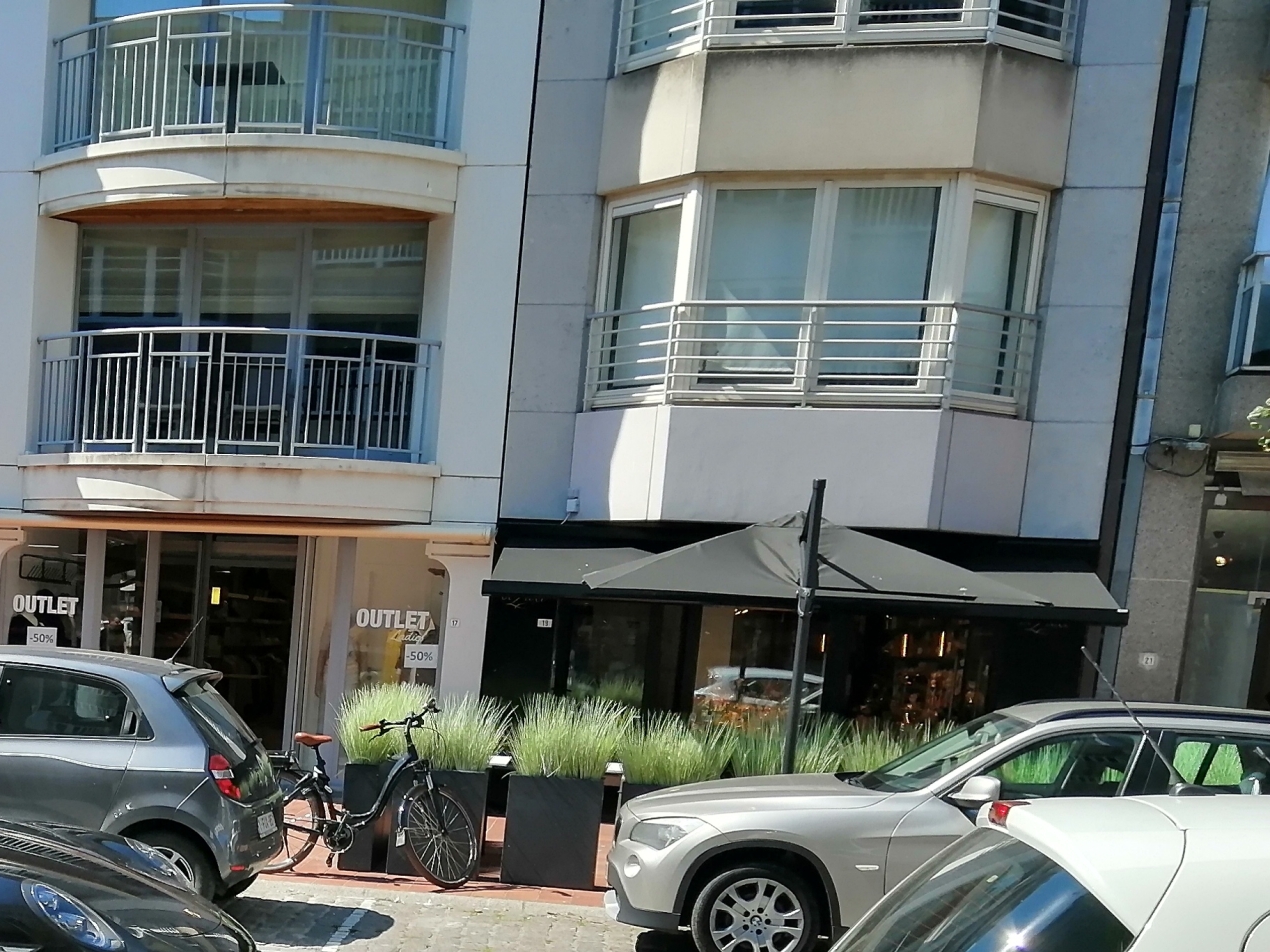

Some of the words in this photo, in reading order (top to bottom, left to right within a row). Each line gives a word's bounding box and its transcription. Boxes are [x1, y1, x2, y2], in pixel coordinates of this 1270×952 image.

[12, 594, 79, 615] OUTLET
[356, 608, 430, 630] OUTLET
[451, 619, 459, 627] 17
[29, 633, 54, 644] -50%
[406, 651, 433, 661] -50%
